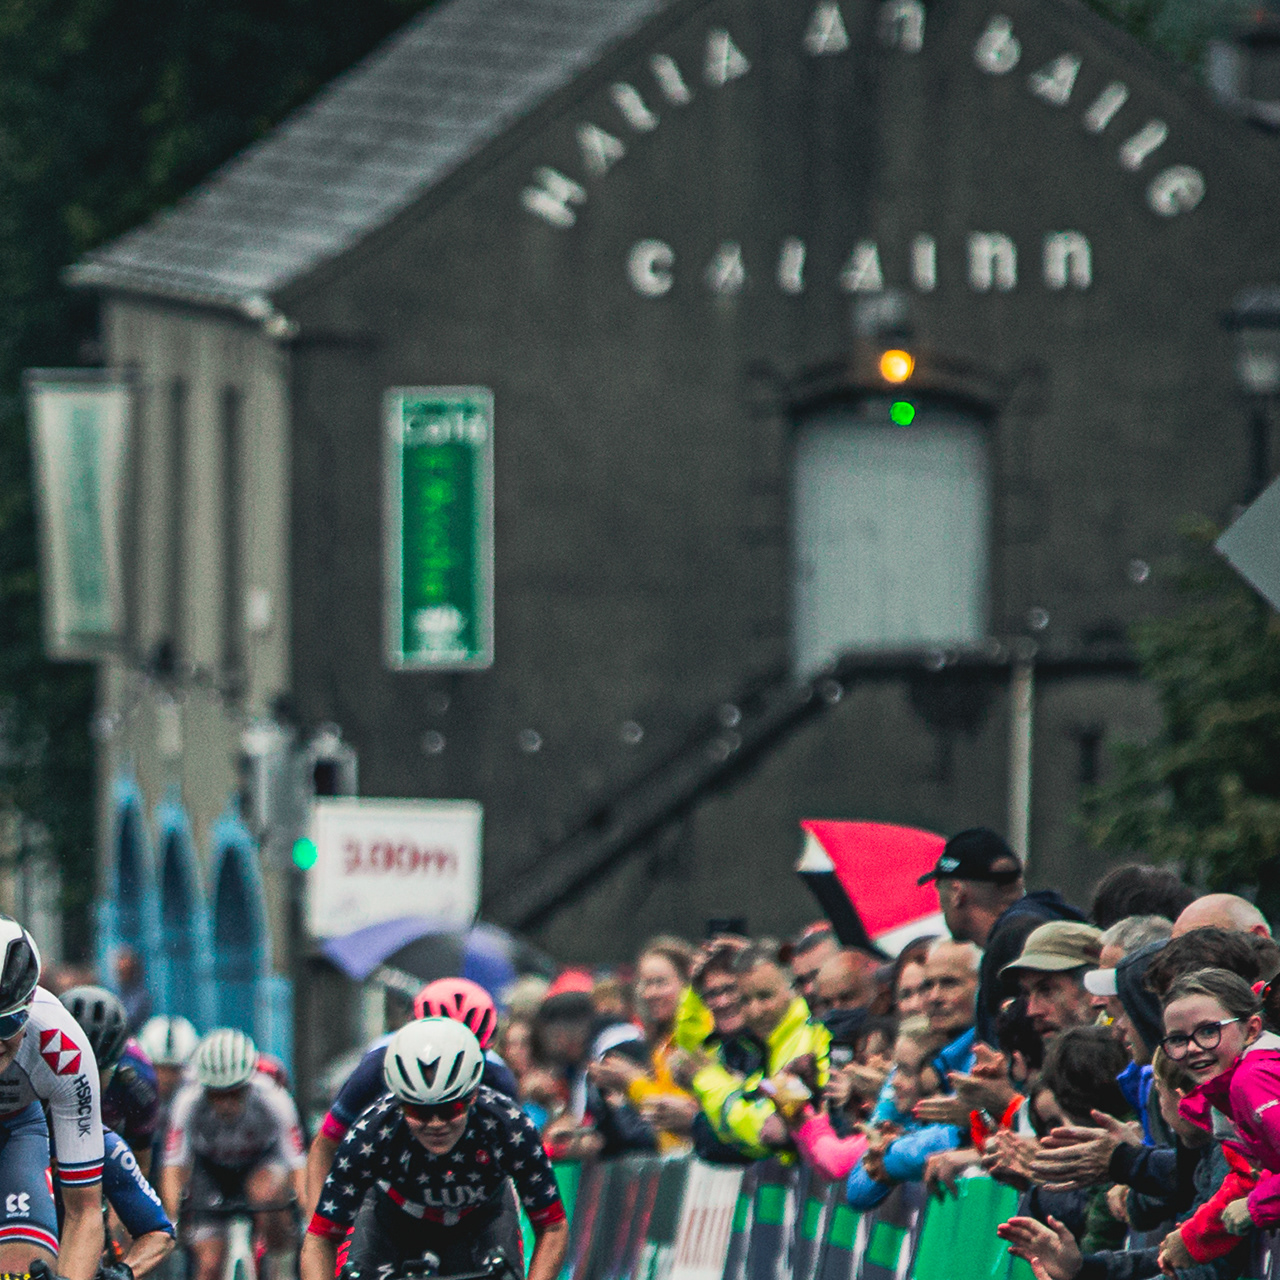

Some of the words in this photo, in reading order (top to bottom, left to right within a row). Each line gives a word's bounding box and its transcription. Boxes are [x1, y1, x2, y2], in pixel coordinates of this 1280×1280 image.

[74, 1074, 92, 1116] HSBC
[78, 1115, 91, 1138] UK
[423, 1185, 488, 1208] LUX
